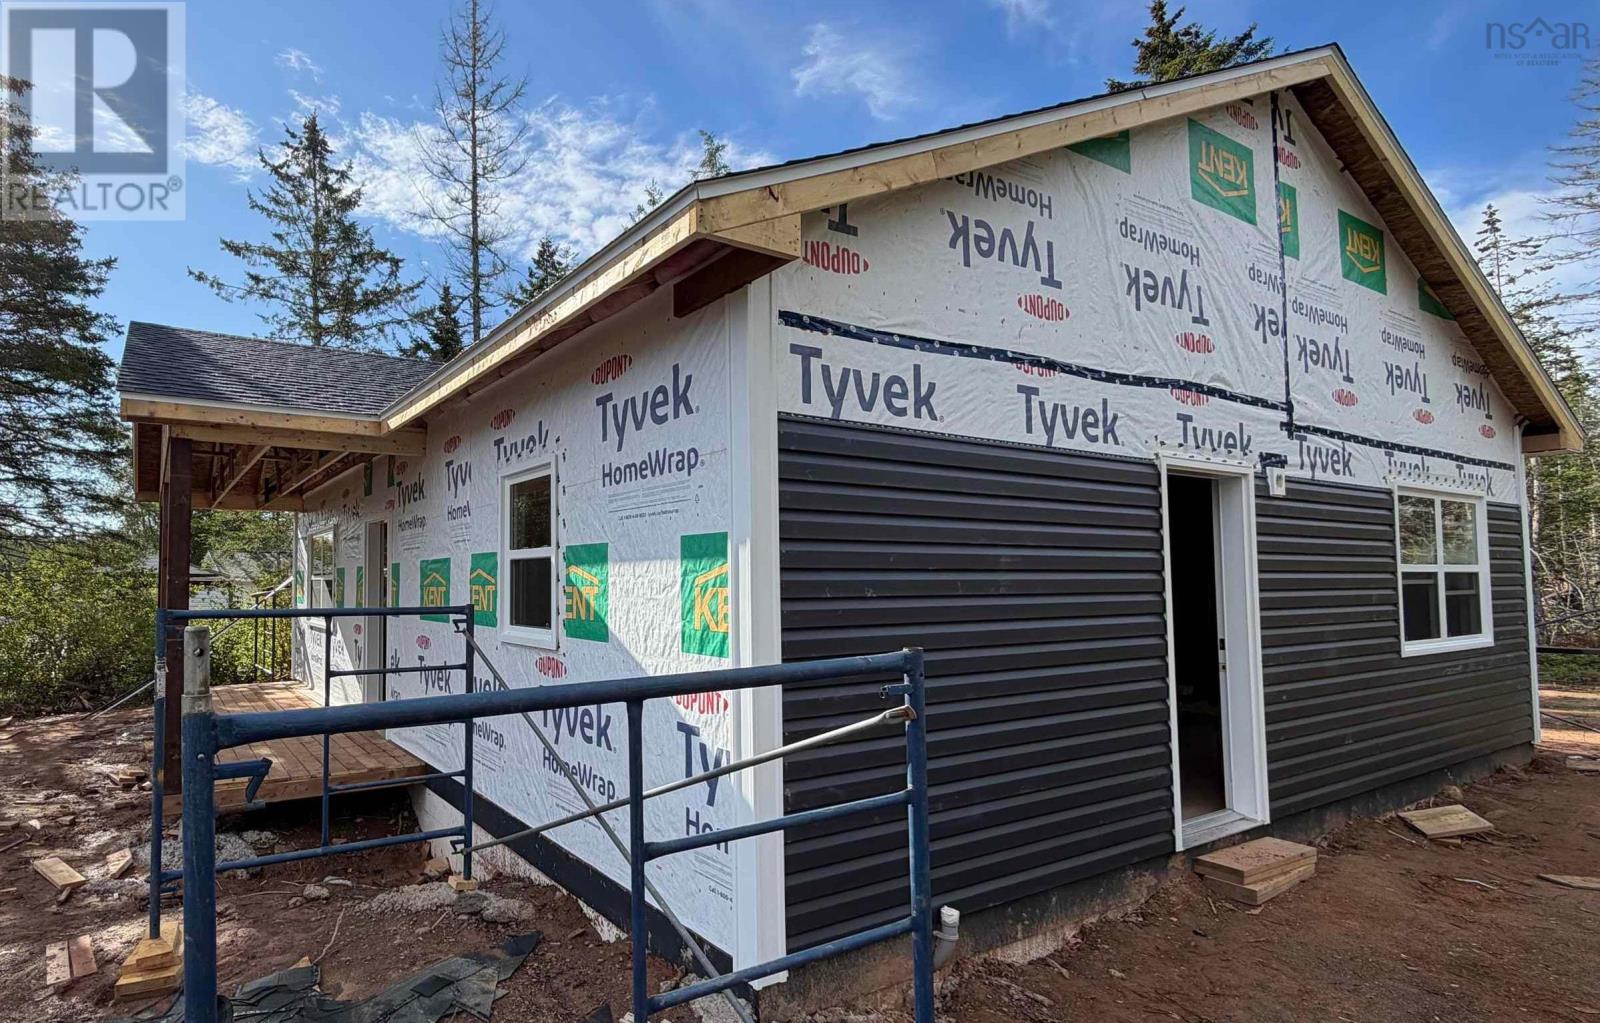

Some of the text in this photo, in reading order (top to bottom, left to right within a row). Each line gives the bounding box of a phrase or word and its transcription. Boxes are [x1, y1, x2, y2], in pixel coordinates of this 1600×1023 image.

[1199, 140, 1249, 189] KENT
[802, 239, 860, 275] DUPONT
[946, 210, 1063, 290] Tyvek
[1119, 216, 1200, 267] HomeWrap
[1346, 227, 1381, 265] KENT
[1023, 294, 1064, 321] DUPONT
[1124, 263, 1210, 327] Tyvek
[1291, 296, 1348, 334] HomeWrap
[1297, 336, 1355, 384] Tyvek
[1381, 327, 1425, 360] HomeWrap
[594, 354, 632, 385] DUPONT
[790, 343, 938, 422] Tyvek
[1384, 361, 1431, 404] Tyvek
[596, 363, 694, 452] Tyvek
[1016, 384, 1120, 446] Tyvek
[1454, 382, 1493, 420] Tyvek
[602, 447, 699, 488] HomeWrap
[1295, 434, 1353, 479] Tyvek
[396, 472, 425, 514] Tyvek
[446, 459, 472, 499] Tyv
[423, 585, 447, 607] KENT
[418, 655, 452, 695] Tyvek
[537, 656, 565, 679] DUPONT
